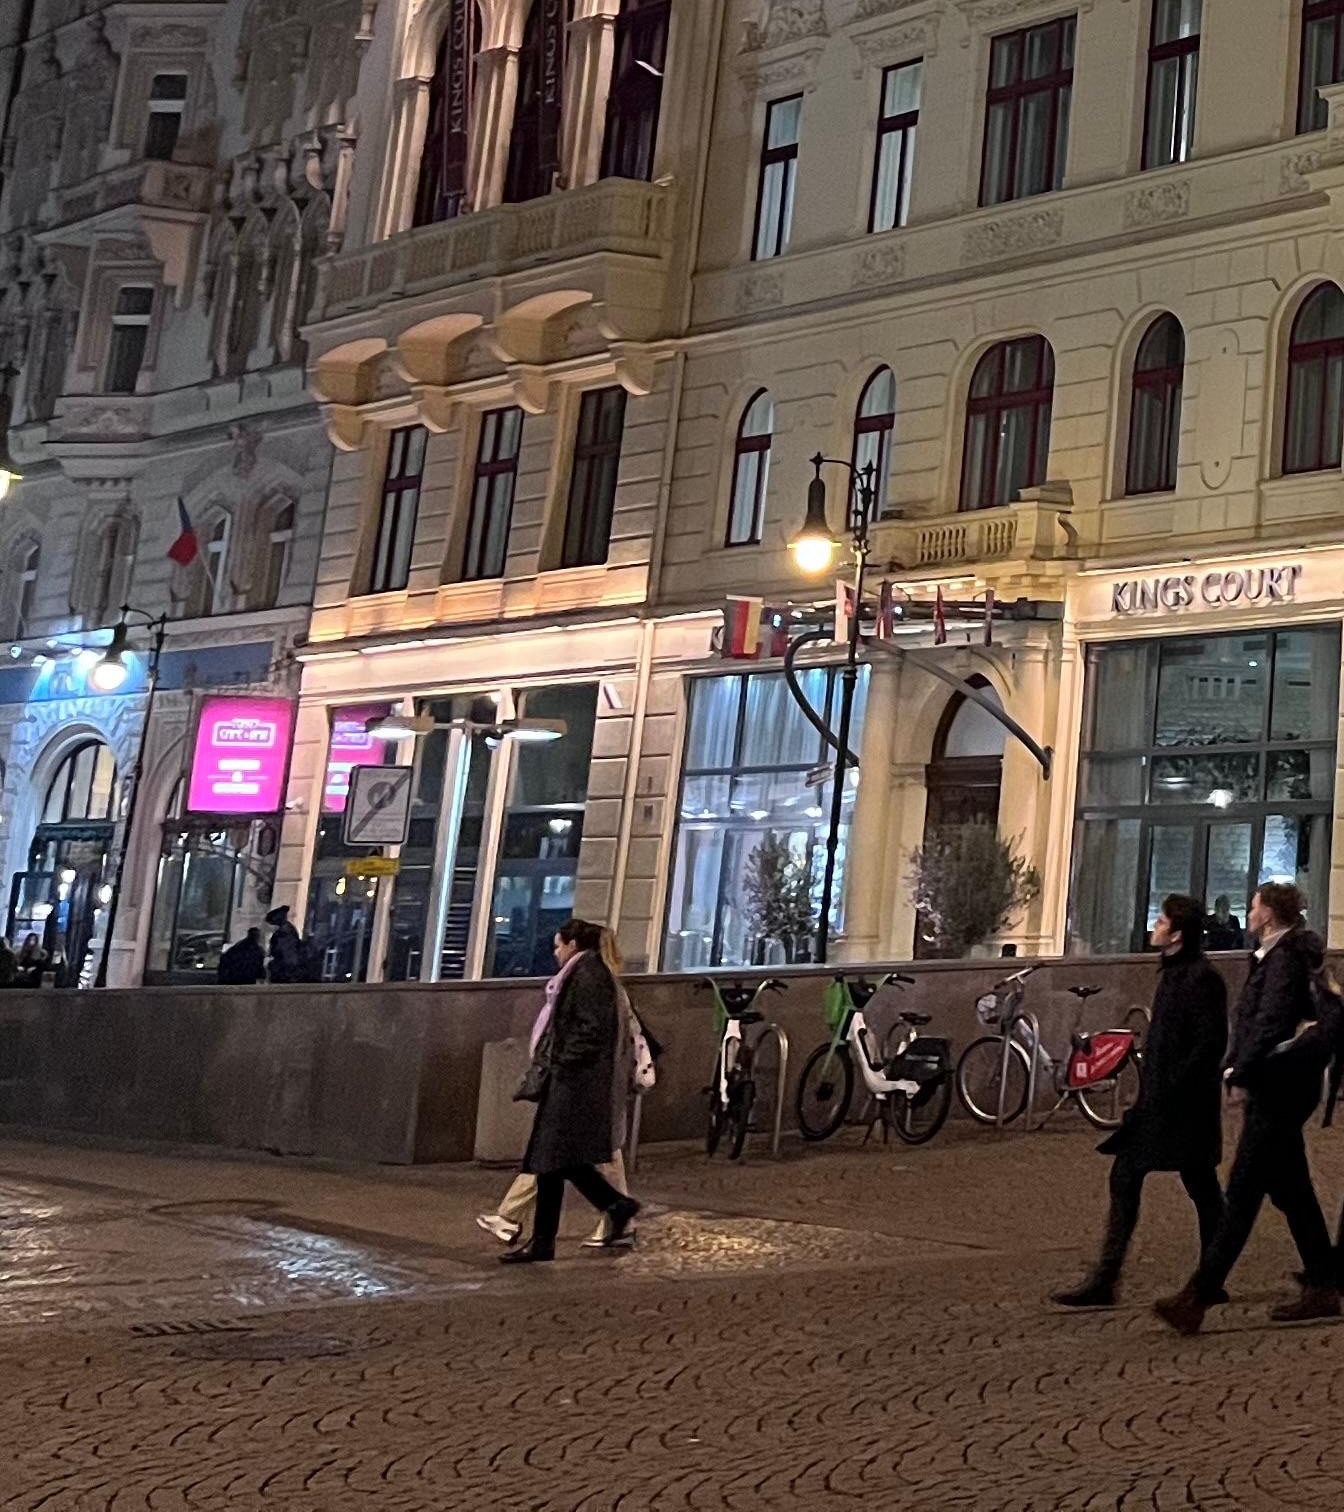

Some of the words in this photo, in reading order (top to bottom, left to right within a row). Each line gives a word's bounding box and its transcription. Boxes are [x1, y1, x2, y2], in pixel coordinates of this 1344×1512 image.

[451, 57, 465, 134] KINGS
[1111, 574, 1195, 613] KINGS
[1201, 564, 1304, 605] COURT
